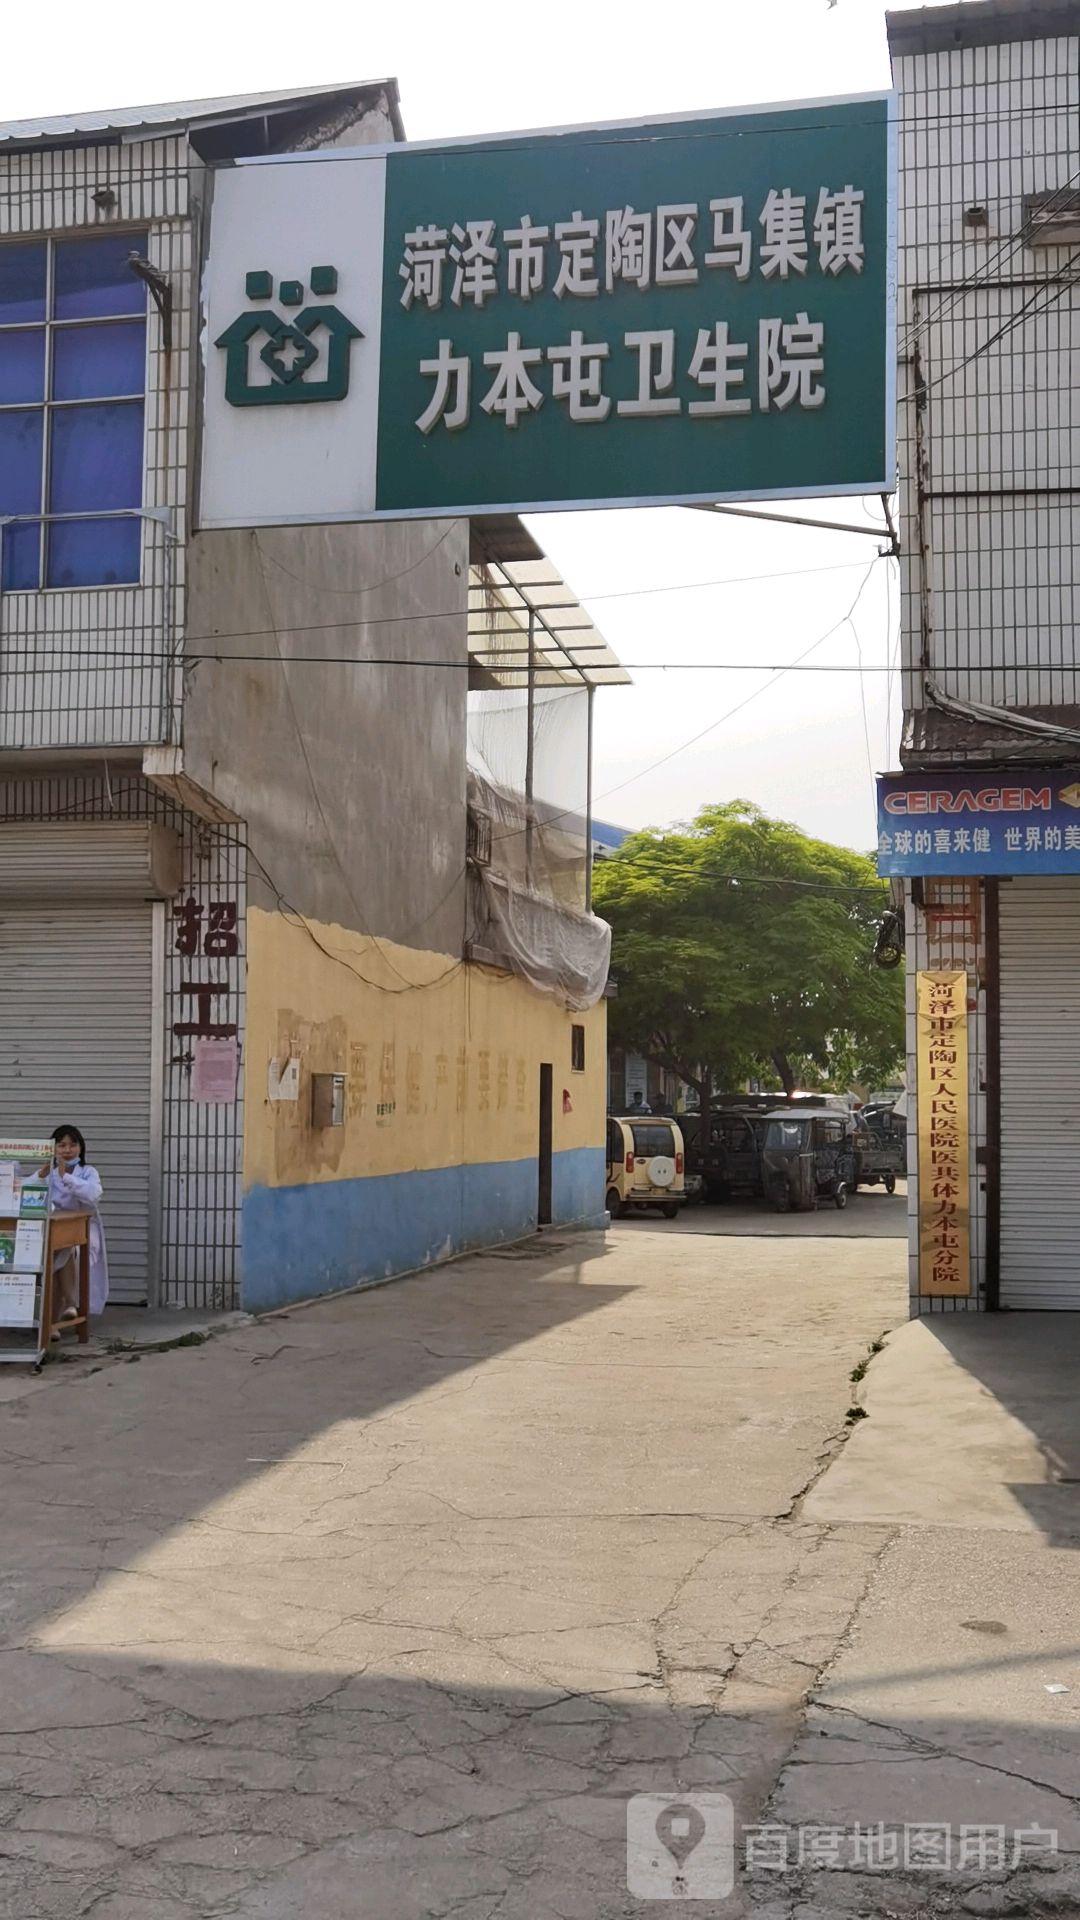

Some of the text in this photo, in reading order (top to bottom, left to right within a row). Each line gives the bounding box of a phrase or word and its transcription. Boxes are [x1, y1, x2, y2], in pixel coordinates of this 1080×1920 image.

[399, 185, 867, 311] 菏泽市定陶区马集镇
[415, 312, 826, 435] 力本屯卫生院
[878, 827, 992, 856] 全球的喜来健
[884, 787, 1052, 815] CERAGEM
[929, 982, 961, 1282] 菏泽市定陶区人民医院医共体力本屯分院
